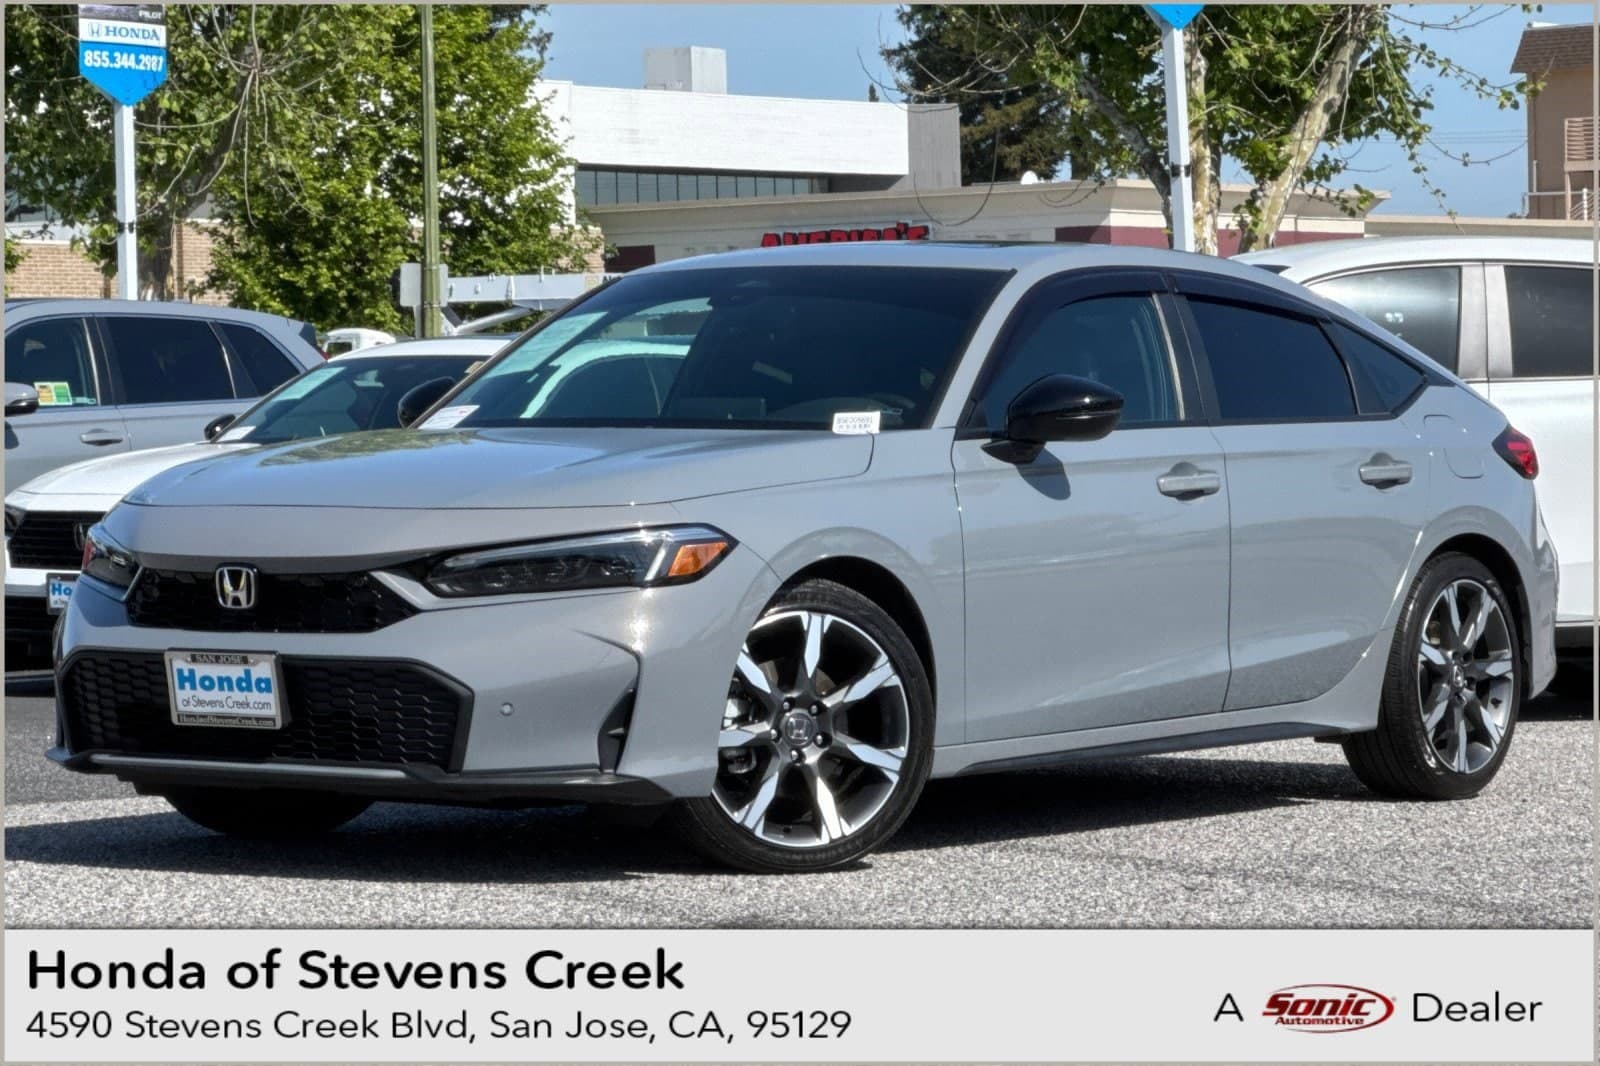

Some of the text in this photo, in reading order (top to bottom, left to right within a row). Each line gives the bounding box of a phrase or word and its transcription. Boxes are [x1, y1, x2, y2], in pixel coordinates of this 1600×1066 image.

[104, 25, 160, 40] HONDA
[83, 49, 164, 72] 855.344.2987
[176, 668, 272, 693] Honda
